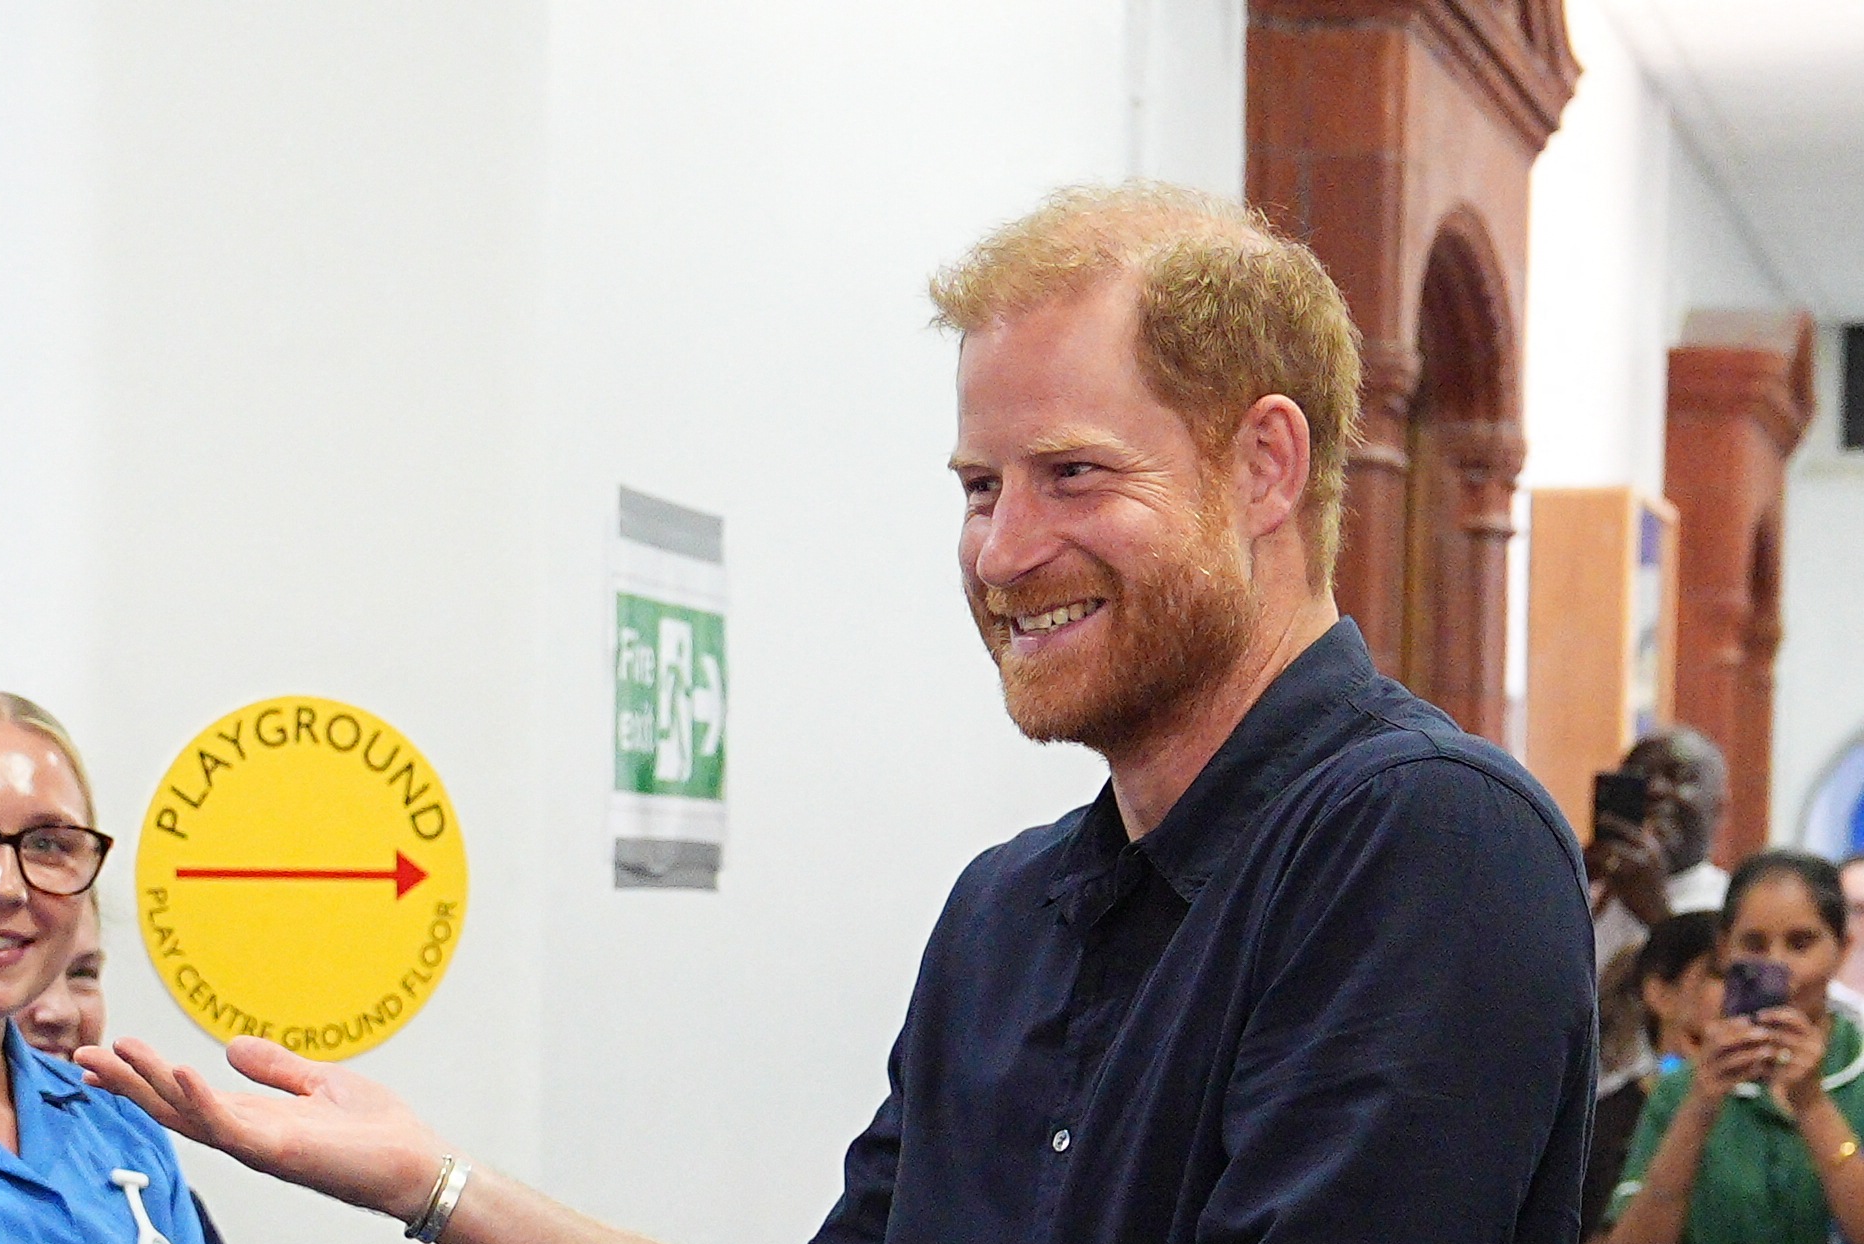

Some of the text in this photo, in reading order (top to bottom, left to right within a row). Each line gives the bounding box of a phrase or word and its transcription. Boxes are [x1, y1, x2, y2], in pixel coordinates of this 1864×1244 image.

[154, 705, 445, 842] PLAYGROUND
[146, 886, 460, 1052] PLAY CENTRE GROUND FLOOR
